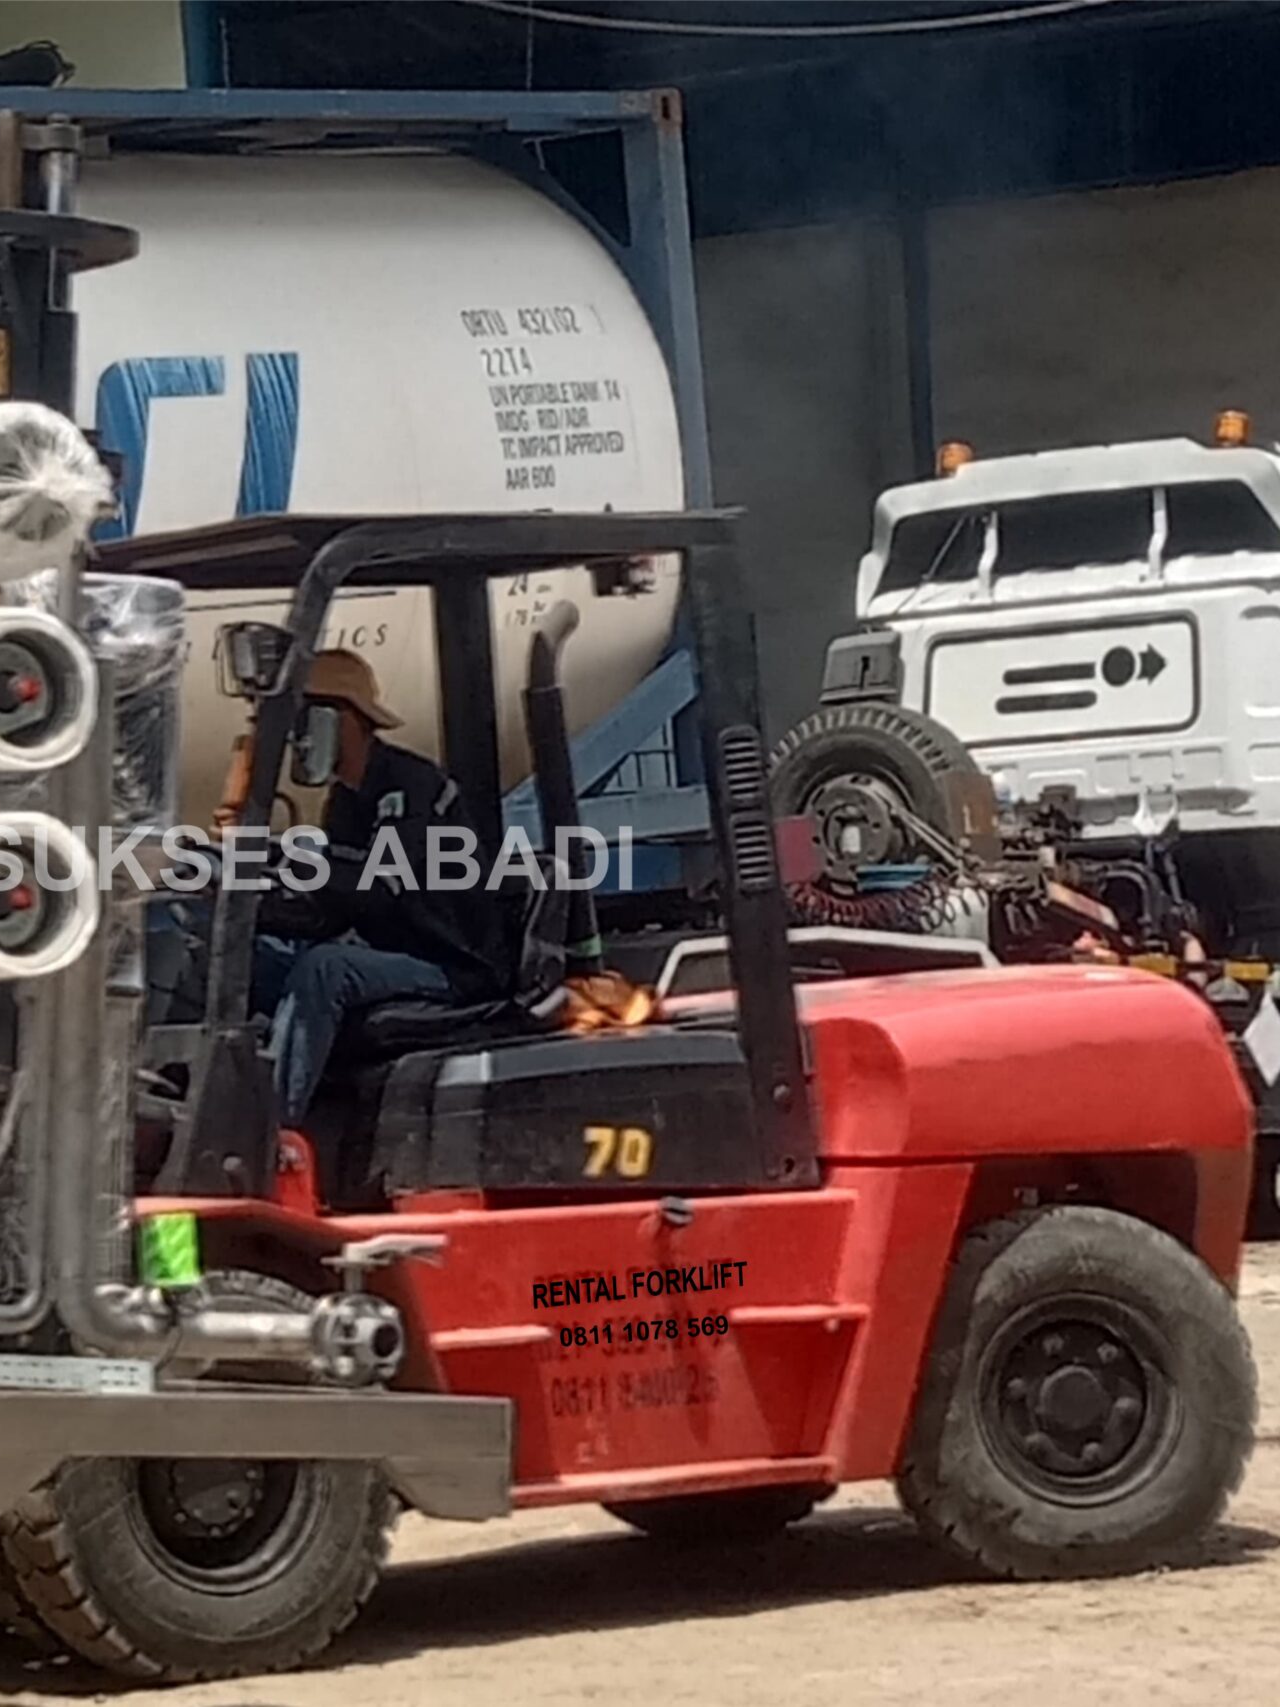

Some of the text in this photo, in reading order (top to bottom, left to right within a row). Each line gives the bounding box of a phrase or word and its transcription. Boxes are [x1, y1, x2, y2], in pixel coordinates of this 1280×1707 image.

[460, 309, 508, 337] ORTU
[517, 306, 581, 335] 432102
[480, 347, 532, 377] 22T4
[488, 385, 509, 408] UN
[509, 382, 570, 406] PORTABLE
[570, 381, 599, 402] TANK
[494, 409, 529, 432] IMDG
[500, 431, 624, 460] TC IMPACT APPROVED
[505, 466, 530, 491] AAR
[581, 1125, 653, 1178] 70
